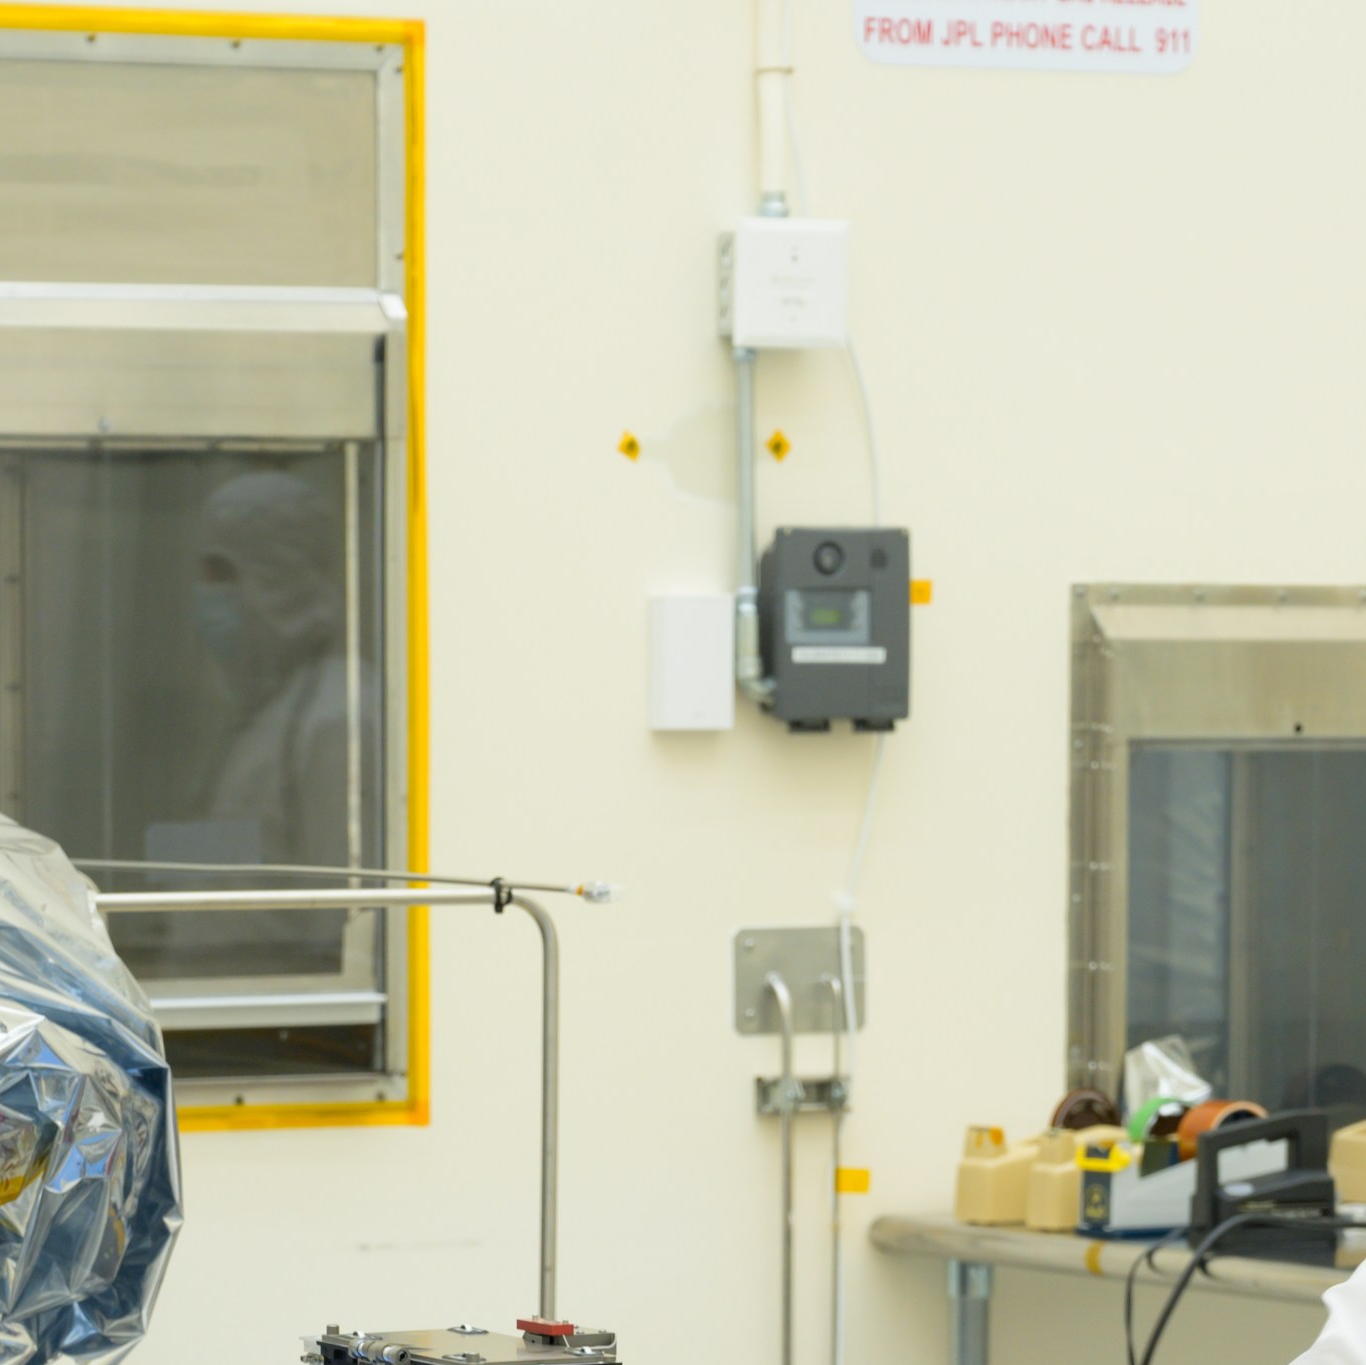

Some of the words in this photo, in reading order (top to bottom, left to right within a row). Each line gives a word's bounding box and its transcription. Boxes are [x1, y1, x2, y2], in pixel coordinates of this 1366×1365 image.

[863, 16, 933, 46] FROM
[941, 20, 984, 47] JPL
[991, 20, 1073, 50] PHONE
[1080, 23, 1142, 53] CALL
[1154, 26, 1192, 54] 911
